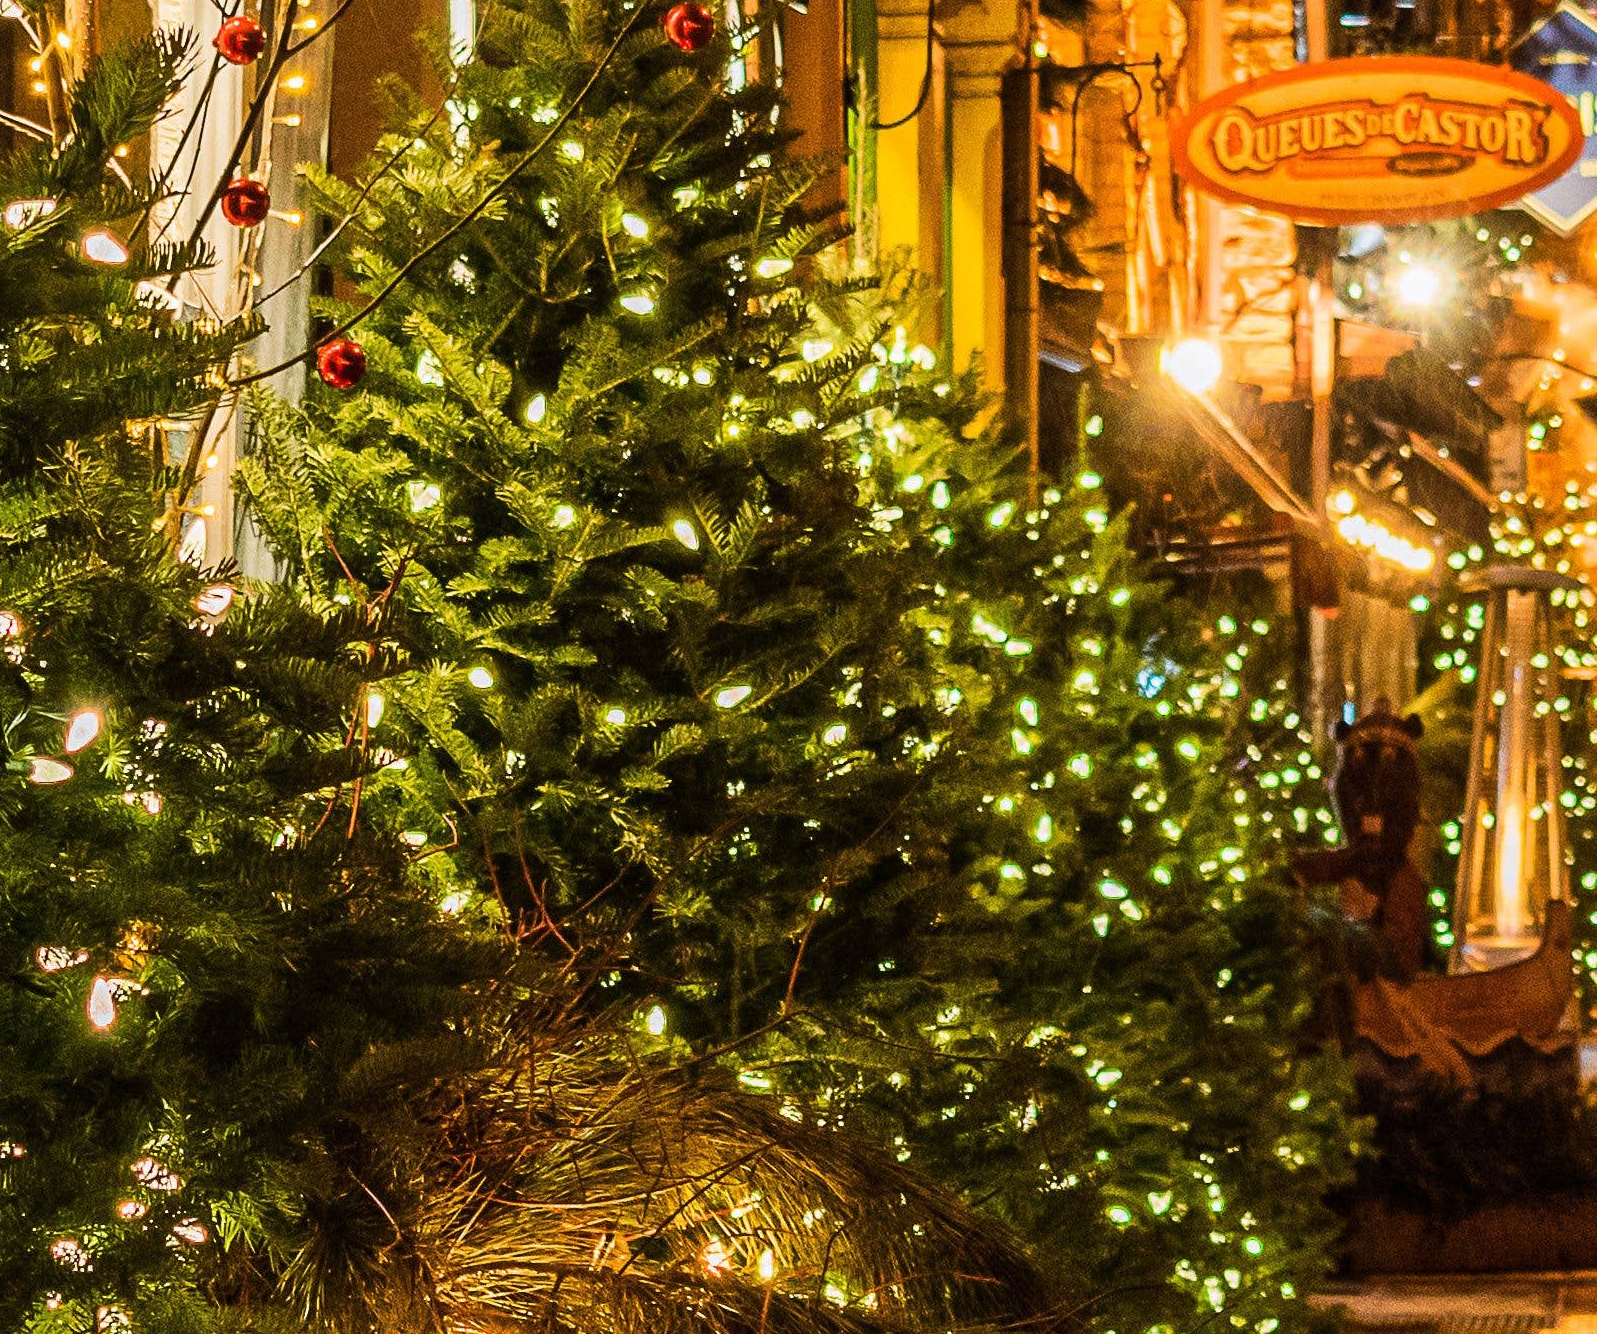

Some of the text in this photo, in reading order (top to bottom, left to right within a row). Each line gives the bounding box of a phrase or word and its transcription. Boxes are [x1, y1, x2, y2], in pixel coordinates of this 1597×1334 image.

[1213, 103, 1536, 173] QUEUES DE CASTOR
